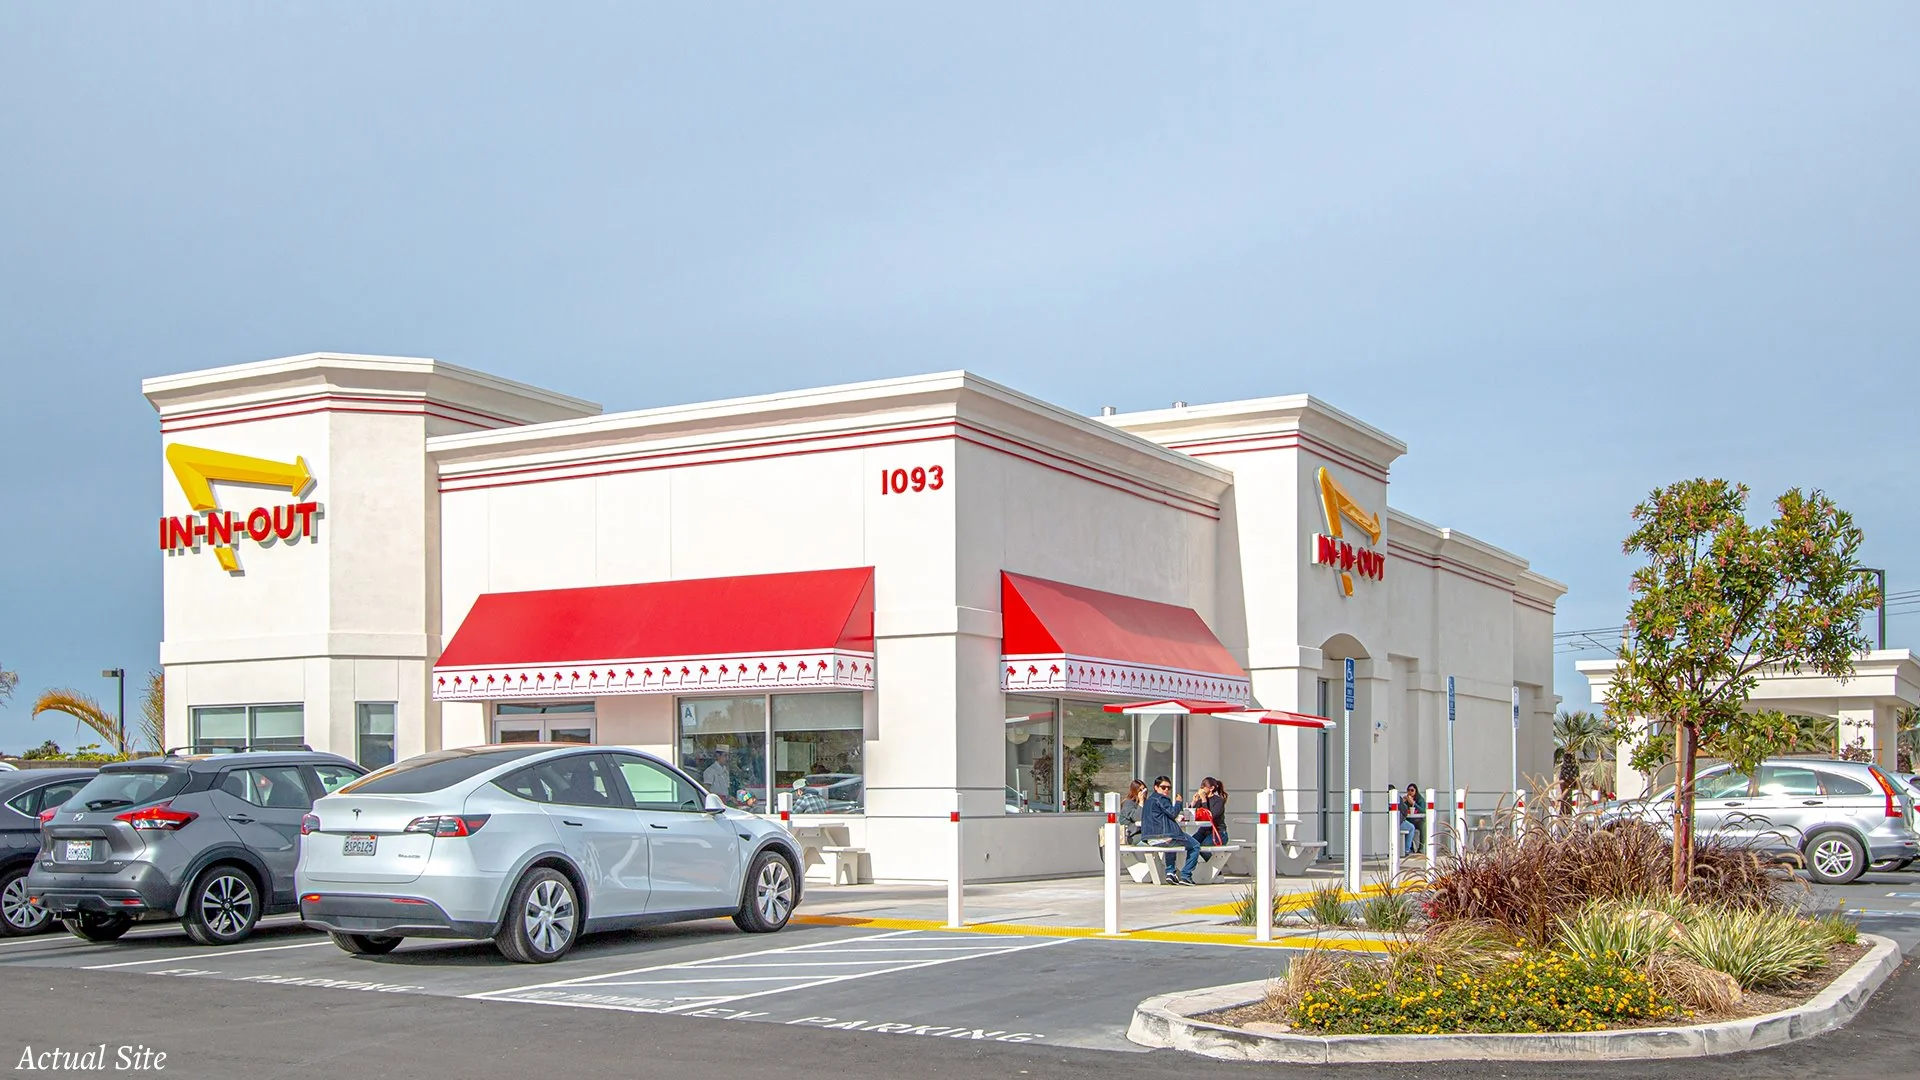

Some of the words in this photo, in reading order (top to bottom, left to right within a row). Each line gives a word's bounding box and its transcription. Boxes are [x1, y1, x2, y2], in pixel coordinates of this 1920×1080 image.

[882, 465, 944, 495] 1093
[160, 501, 318, 550] IN-N-OUT
[1317, 533, 1385, 582] IN-N-OUT
[680, 1007, 770, 1020] EV
[785, 1016, 1045, 1042] PARKING
